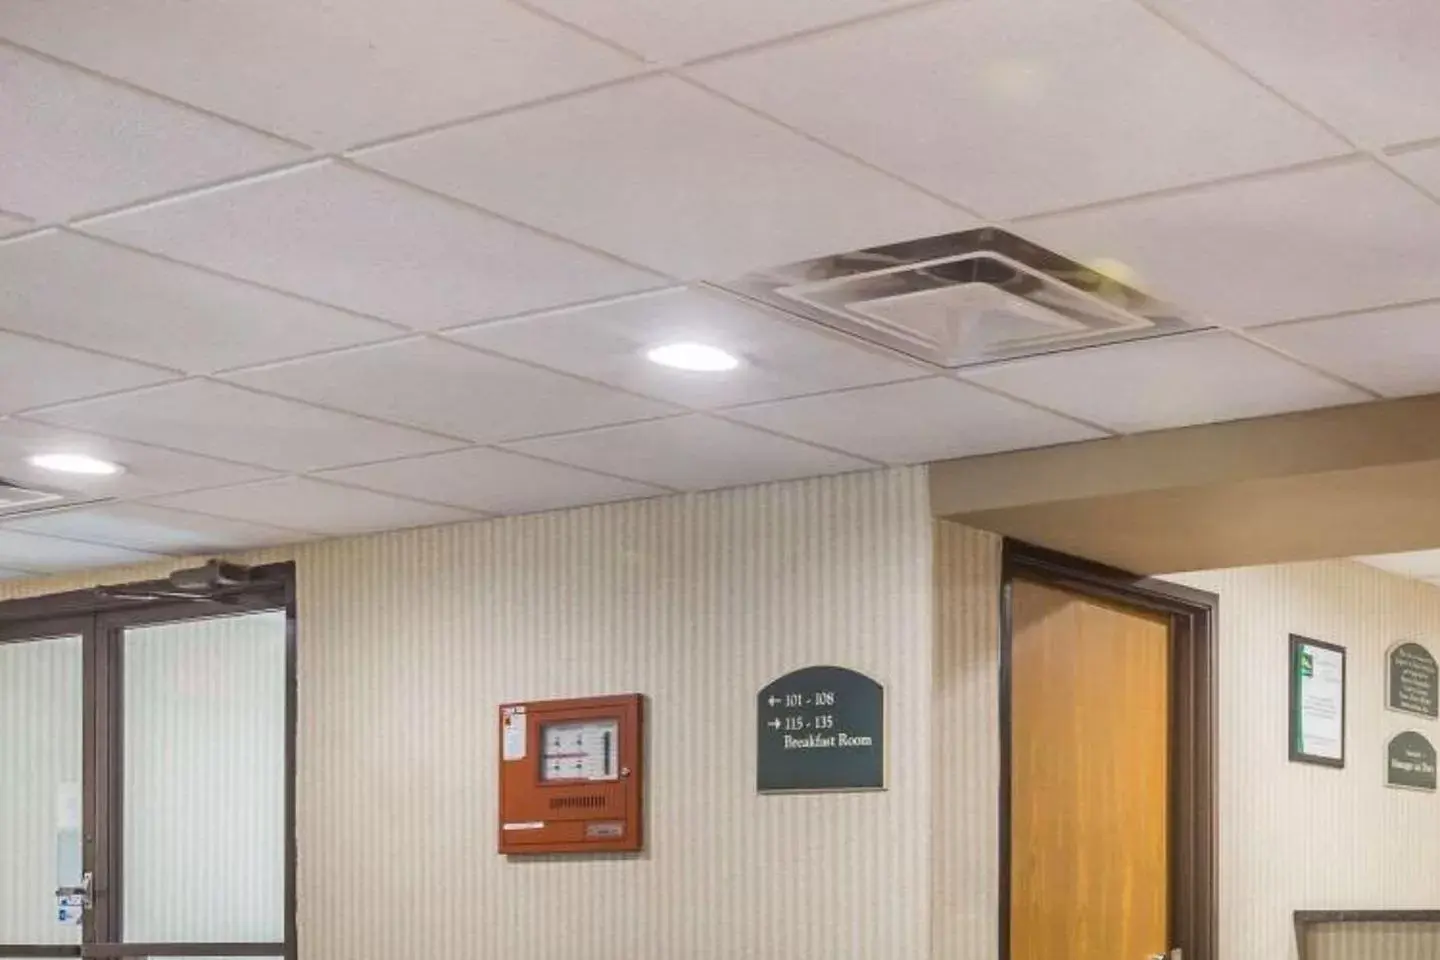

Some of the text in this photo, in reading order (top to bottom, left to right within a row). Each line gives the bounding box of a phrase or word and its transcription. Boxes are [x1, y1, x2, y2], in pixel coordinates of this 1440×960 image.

[786, 694, 802, 707] 101
[815, 692, 834, 706] 108
[785, 717, 803, 730] 115
[815, 716, 832, 729] 135
[784, 733, 872, 748] Breakfast Room
